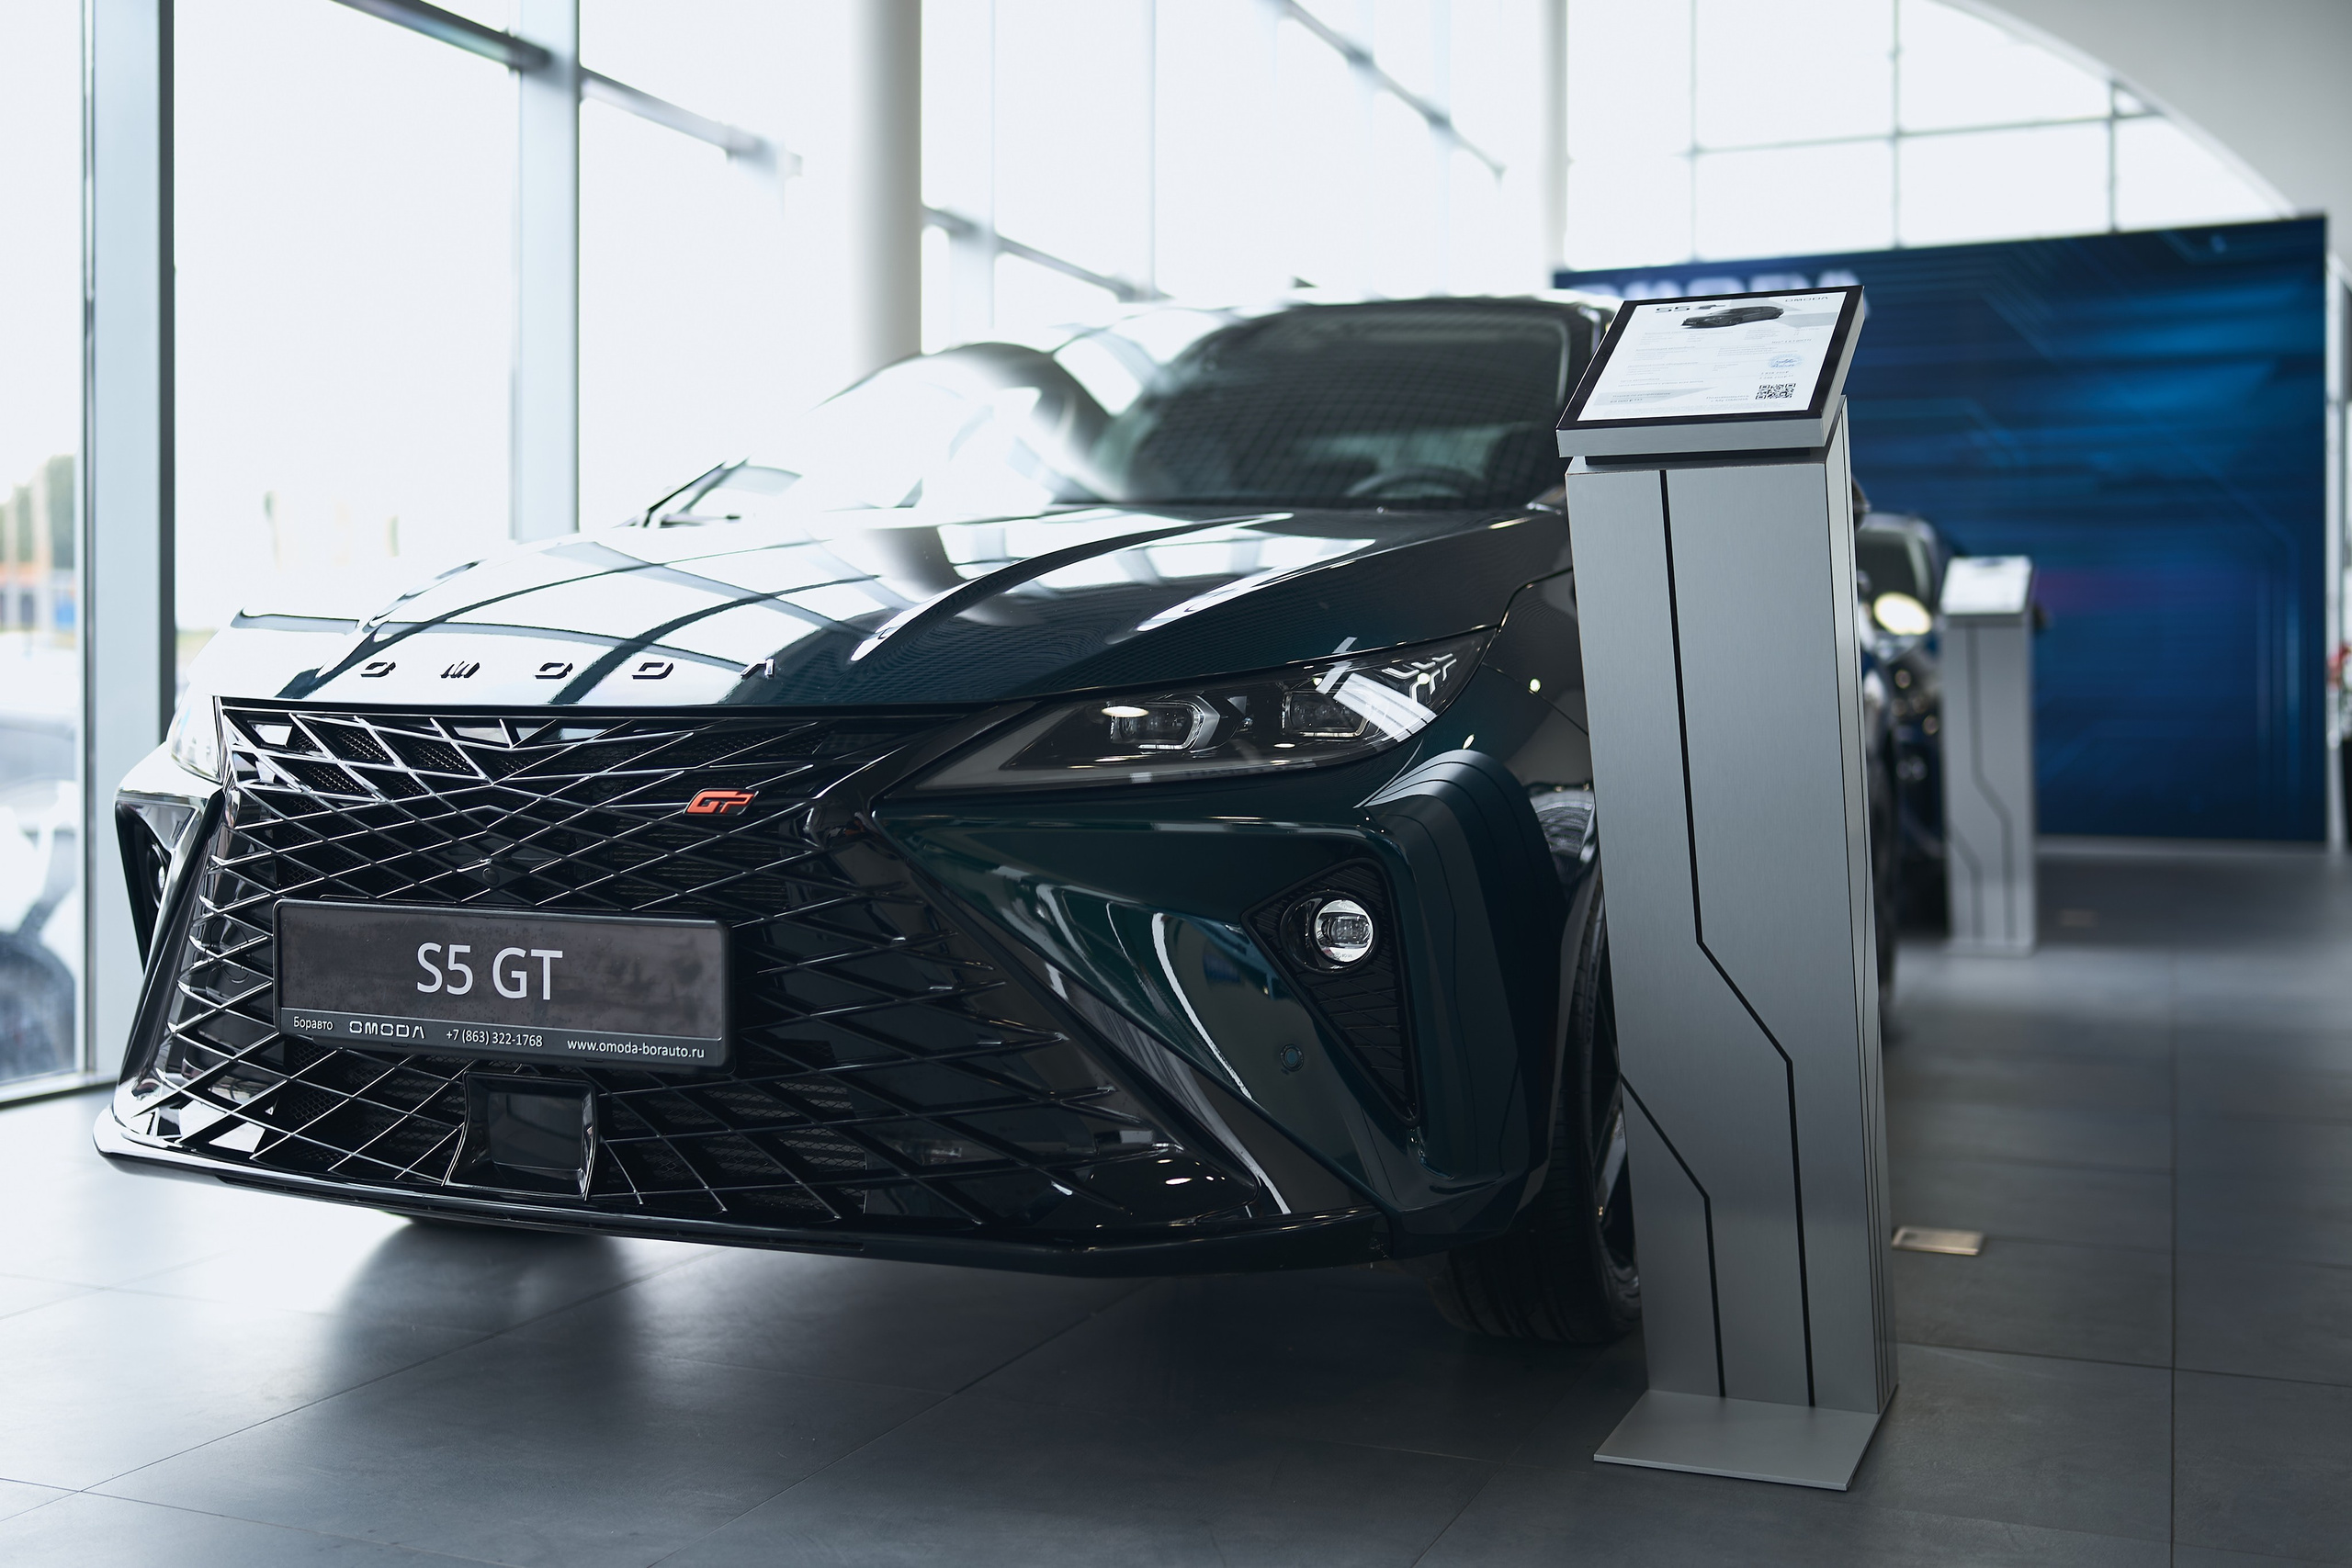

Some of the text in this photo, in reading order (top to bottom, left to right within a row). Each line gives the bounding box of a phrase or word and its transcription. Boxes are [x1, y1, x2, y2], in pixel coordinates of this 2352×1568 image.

[1655, 305, 1691, 314] S5
[686, 790, 754, 814] GT
[416, 942, 564, 1000] S5 GT
[293, 1016, 706, 1058] Боравто OMODA +7 (863) 322-1768 www.omoda-borauto.ru
